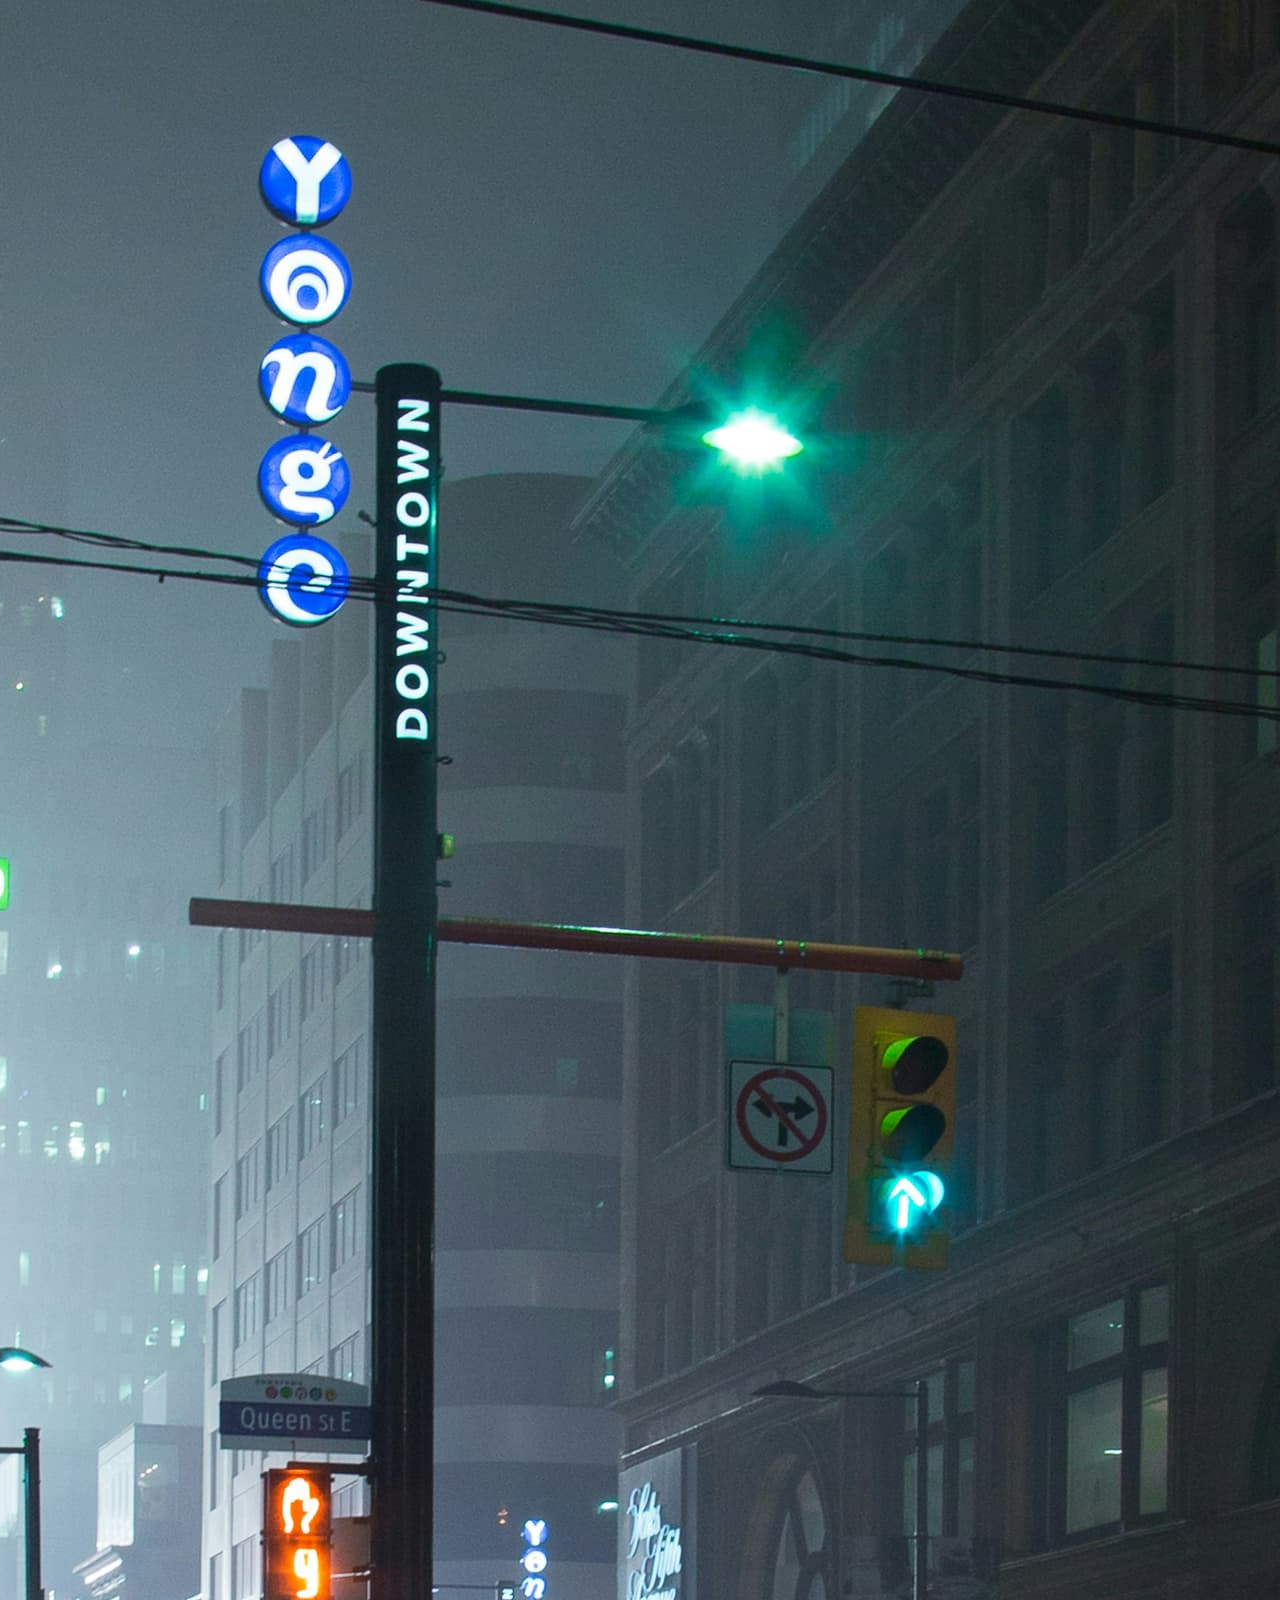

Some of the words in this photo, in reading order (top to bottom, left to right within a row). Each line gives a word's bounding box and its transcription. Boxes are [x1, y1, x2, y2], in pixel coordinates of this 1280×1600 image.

[261, 137, 348, 624] Yonge
[396, 398, 430, 740] DOWNTOWN
[240, 1406, 312, 1431] Queen
[320, 1413, 336, 1432] St
[341, 1410, 353, 1433] E
